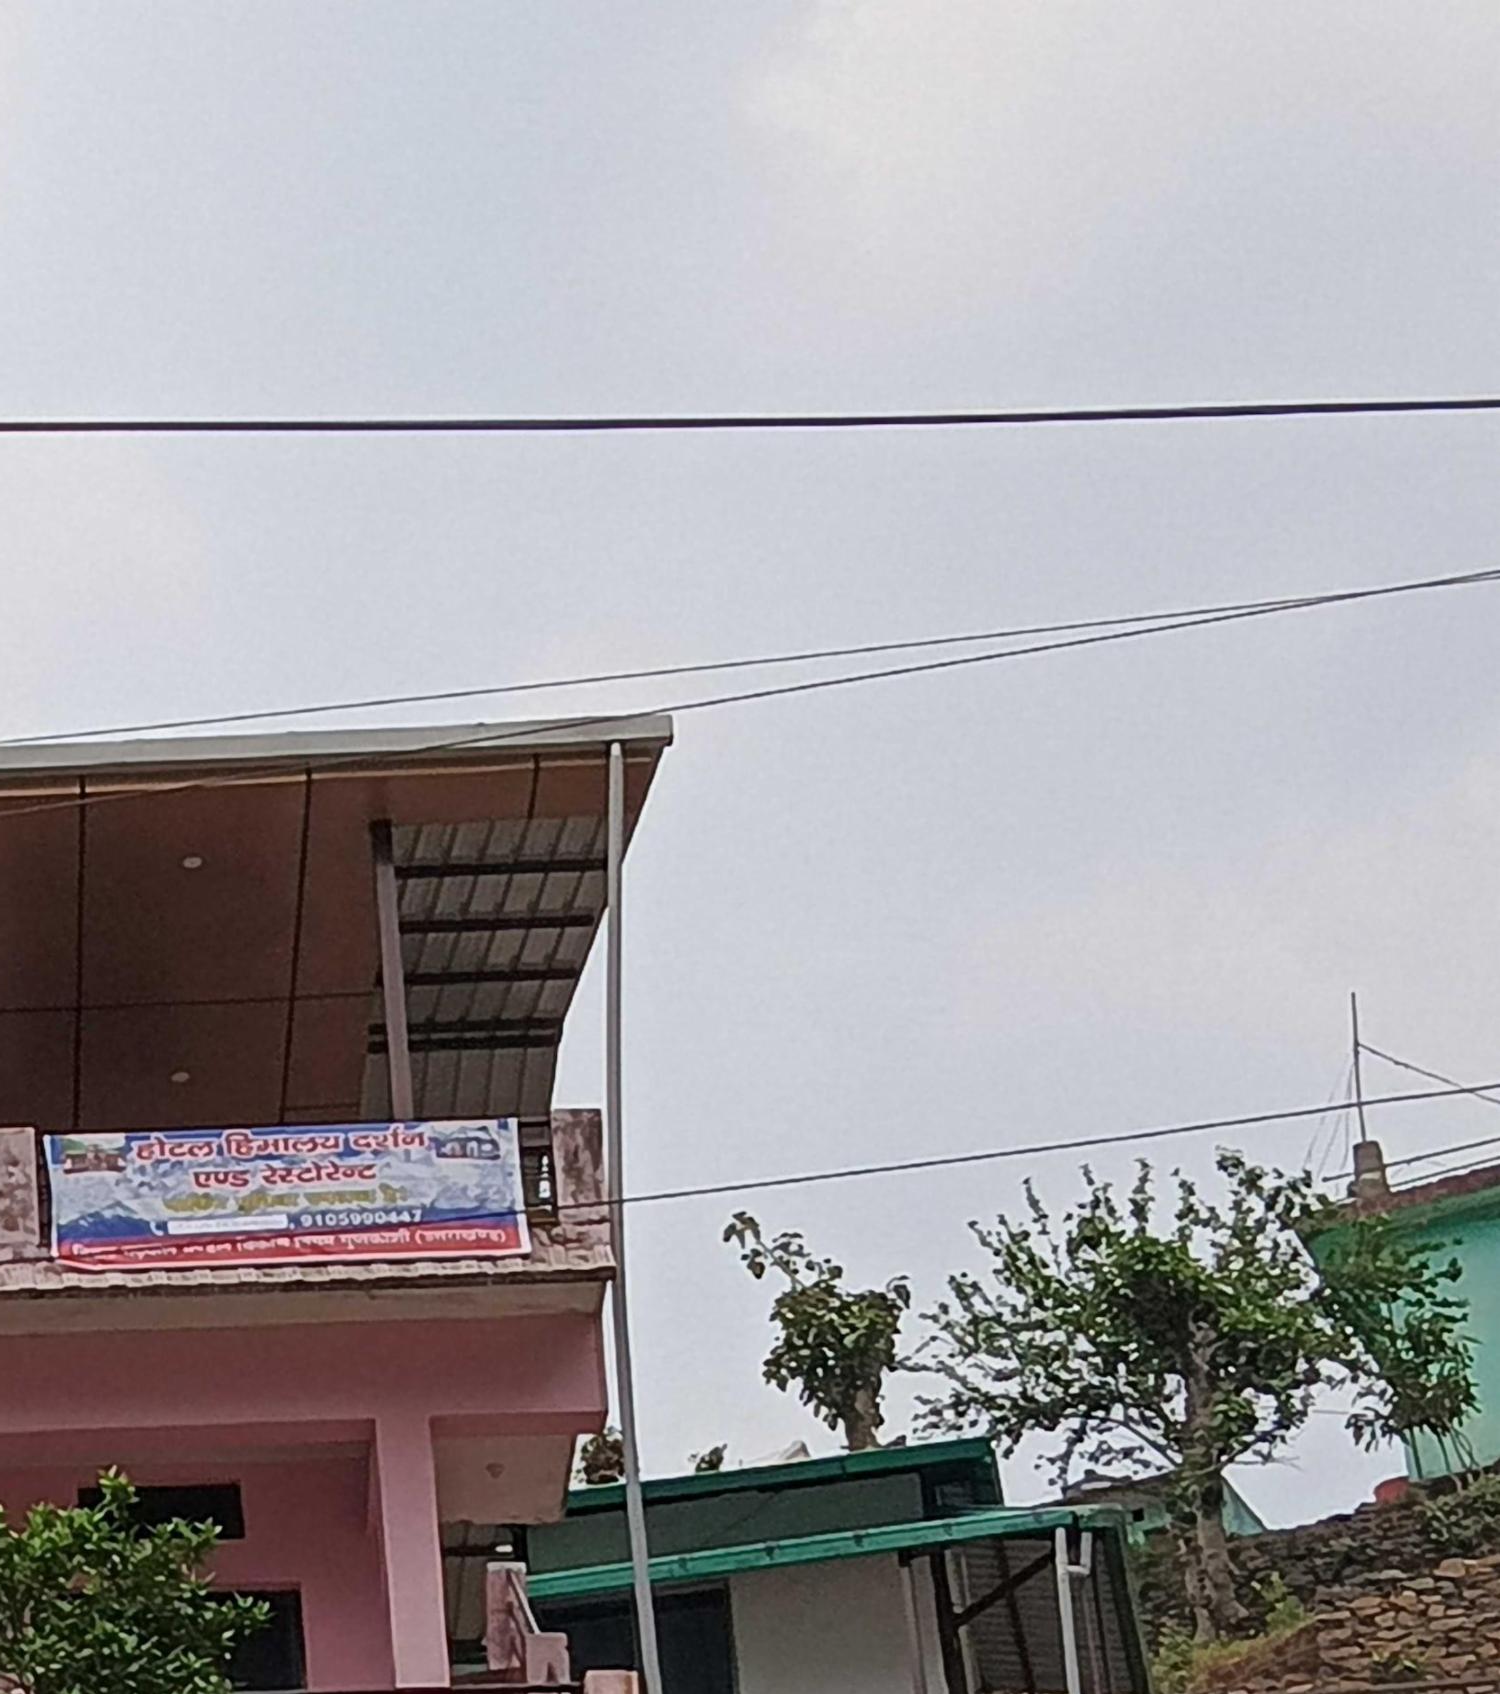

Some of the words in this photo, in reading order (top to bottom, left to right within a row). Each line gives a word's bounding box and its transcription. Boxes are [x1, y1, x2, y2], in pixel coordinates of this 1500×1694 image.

[136, 1137, 214, 1160] होटल
[225, 1132, 340, 1155] हिमालय
[352, 1127, 425, 1149] दर्शन
[192, 1170, 250, 1188] एण्ड
